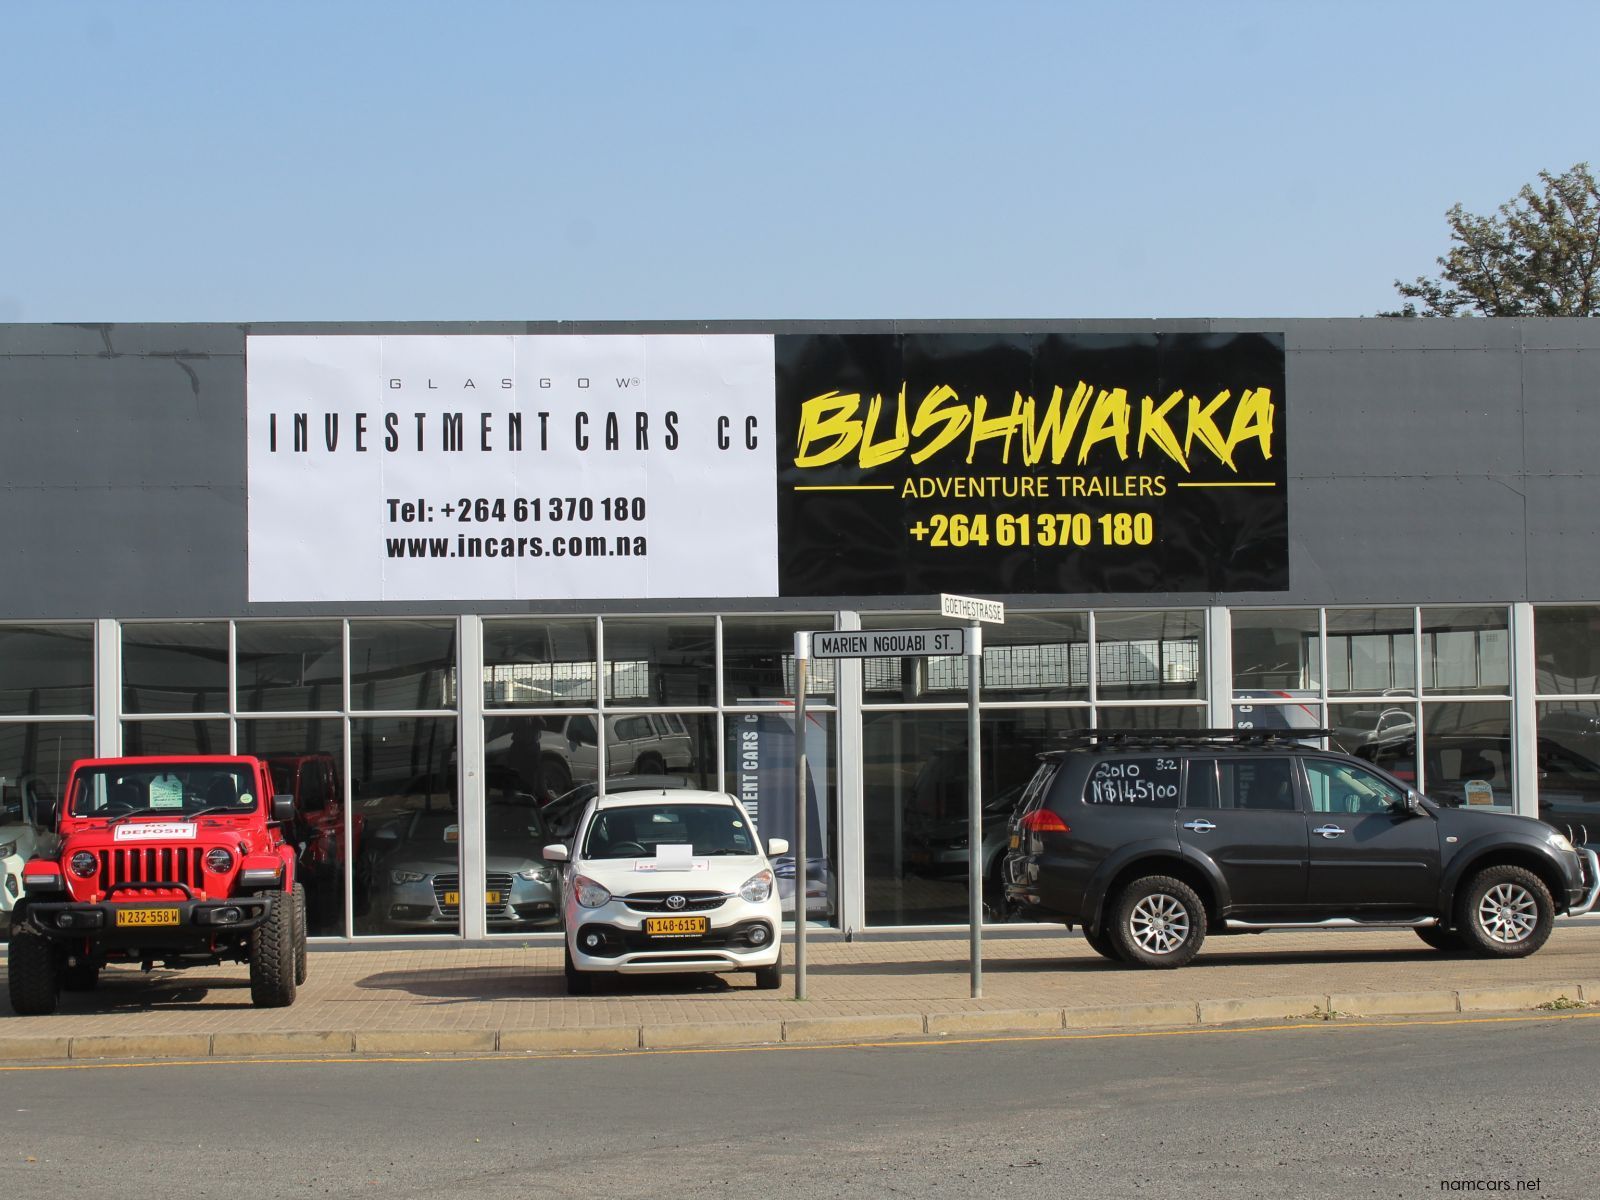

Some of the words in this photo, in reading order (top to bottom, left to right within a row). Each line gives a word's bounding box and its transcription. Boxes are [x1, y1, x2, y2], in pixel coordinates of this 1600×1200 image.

[389, 377, 631, 389] GLASGOW
[269, 411, 550, 453] INVESTMENT
[575, 410, 679, 452] CARS
[794, 380, 1276, 473] BUSHWAKKA
[901, 475, 1049, 499] ADVENTURE
[1057, 475, 1168, 498] TRAILERS
[386, 498, 434, 523] Tel:
[440, 497, 507, 523] +264
[513, 497, 542, 523] 61
[548, 497, 594, 523] 370
[600, 496, 646, 522] 180
[909, 513, 990, 548] +264
[995, 512, 1031, 547] 61
[1036, 512, 1093, 547] 370
[1097, 512, 1154, 546] 180
[386, 533, 647, 558] www.incars.com.na
[944, 597, 1002, 621] GOETHESTRASSE
[821, 636, 868, 654] MARIEN
[873, 635, 926, 653] NGOUABI
[934, 634, 954, 651] ST.
[742, 731, 759, 770] CARS
[1095, 762, 1140, 778] 2010
[1155, 758, 1177, 771] 3.2
[119, 911, 126, 924] N
[127, 910, 170, 923] 232-558
[171, 911, 178, 922] W
[648, 921, 654, 932] N
[656, 919, 696, 931] 148-615
[699, 919, 705, 930] W
